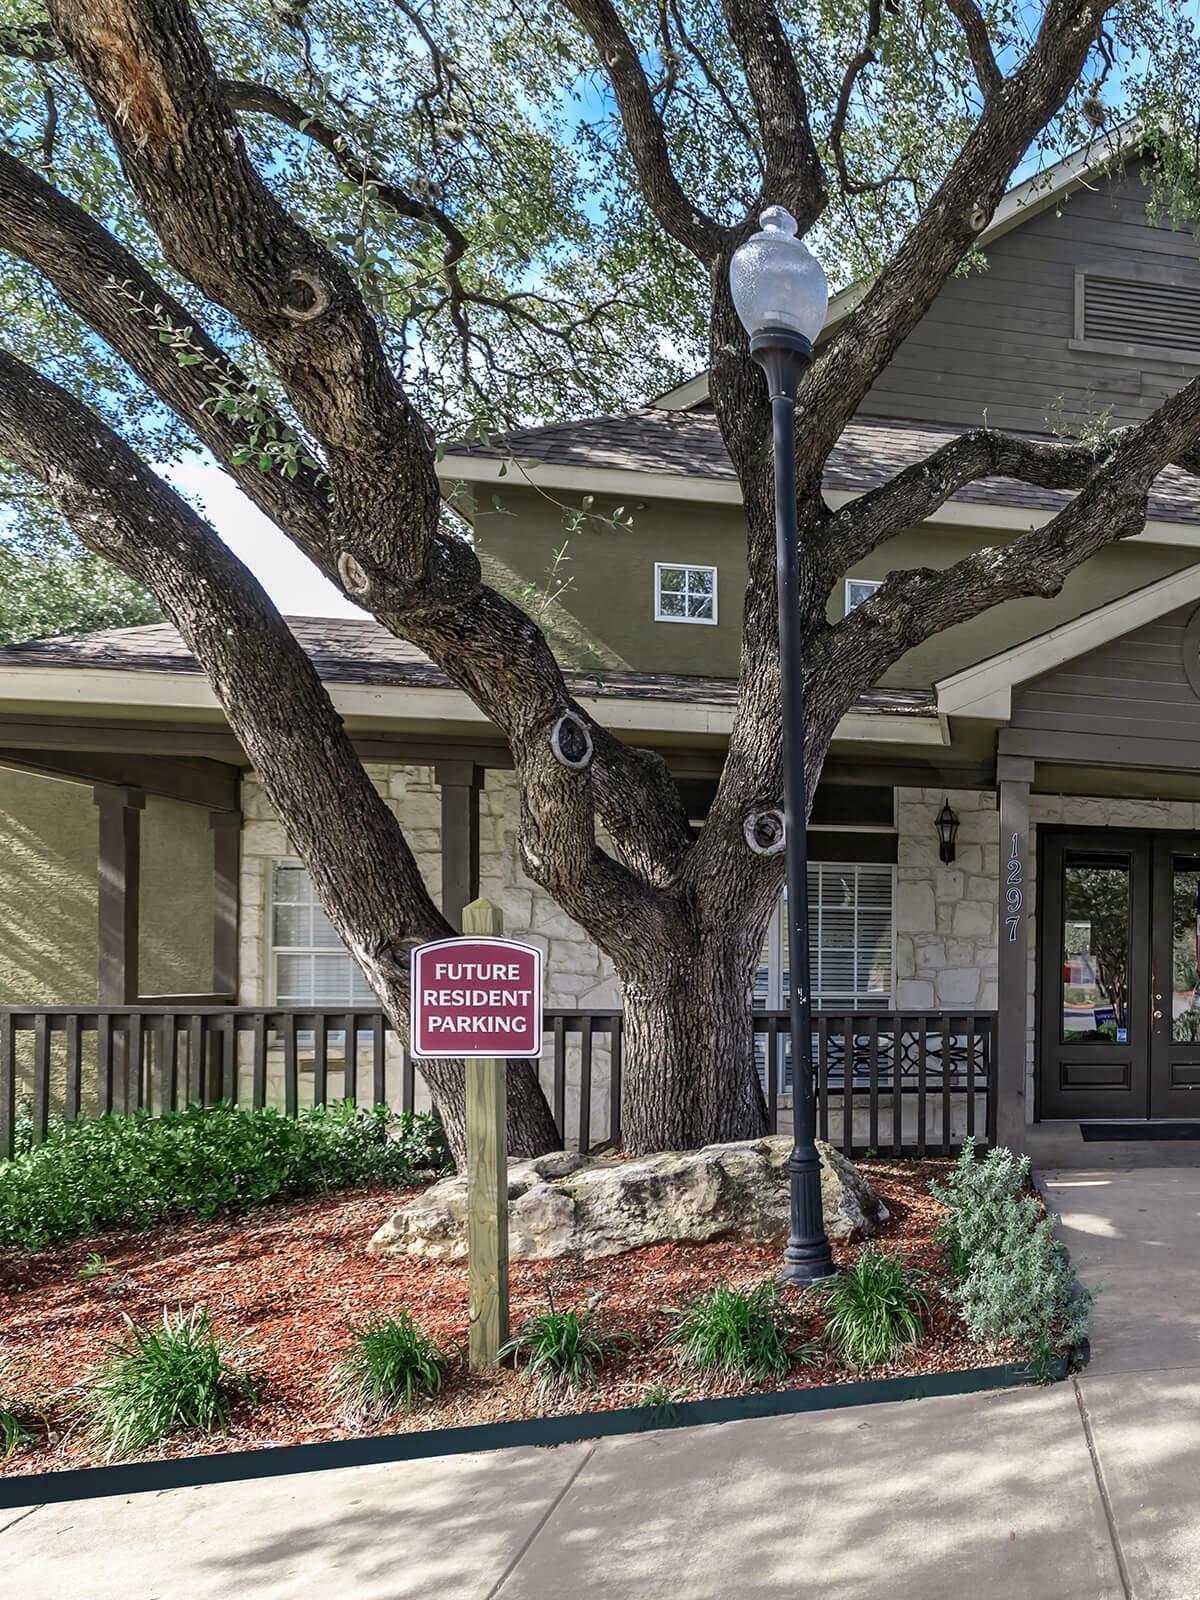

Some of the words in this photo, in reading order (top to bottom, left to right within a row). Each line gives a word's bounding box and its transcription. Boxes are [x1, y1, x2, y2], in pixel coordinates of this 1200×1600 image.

[1005, 832, 1023, 941] 1297
[435, 963, 520, 980] FUTURE
[423, 989, 532, 1007] RESIDENT
[428, 1015, 527, 1033] PARKING
